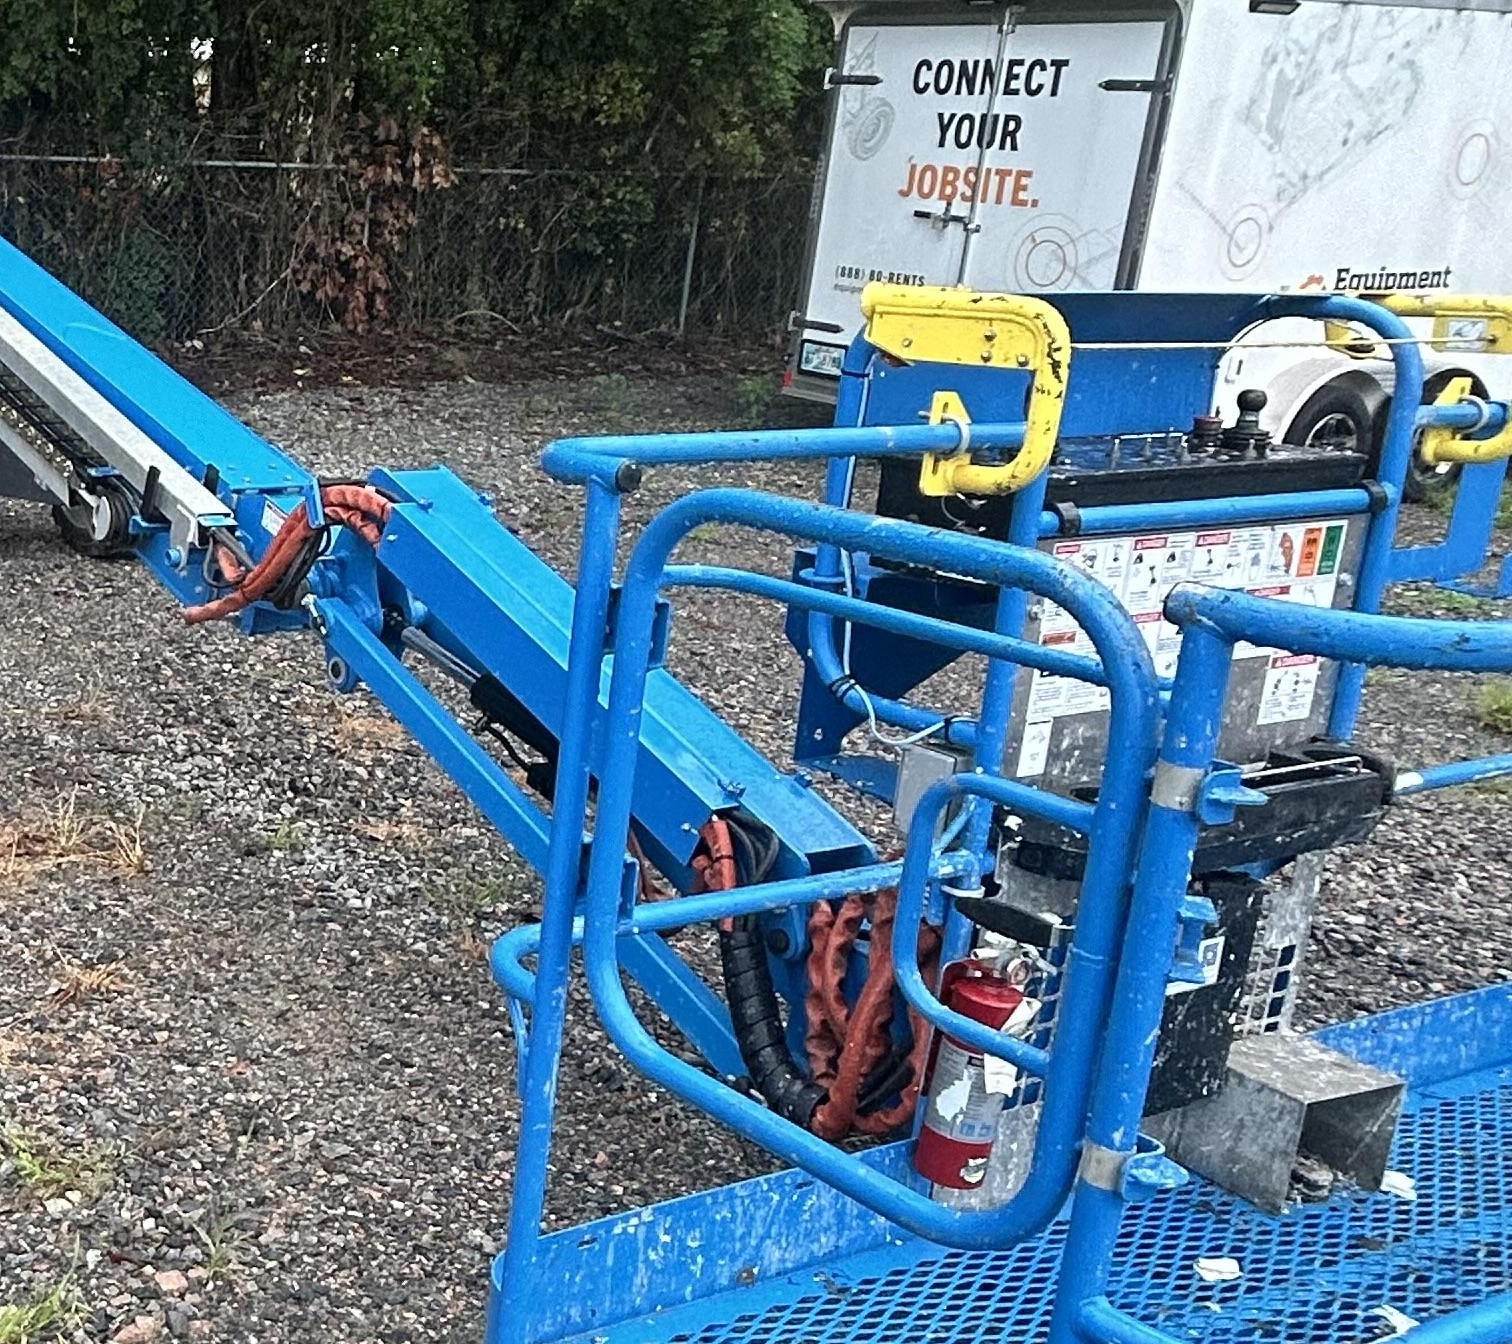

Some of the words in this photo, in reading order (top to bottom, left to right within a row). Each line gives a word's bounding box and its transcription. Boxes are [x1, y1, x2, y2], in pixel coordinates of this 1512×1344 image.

[913, 58, 1070, 97] CONNECT
[937, 112, 1022, 151] YOUR
[897, 163, 1040, 208] JOBSITE.
[835, 264, 866, 281] (888)
[1334, 265, 1452, 292] Equipment
